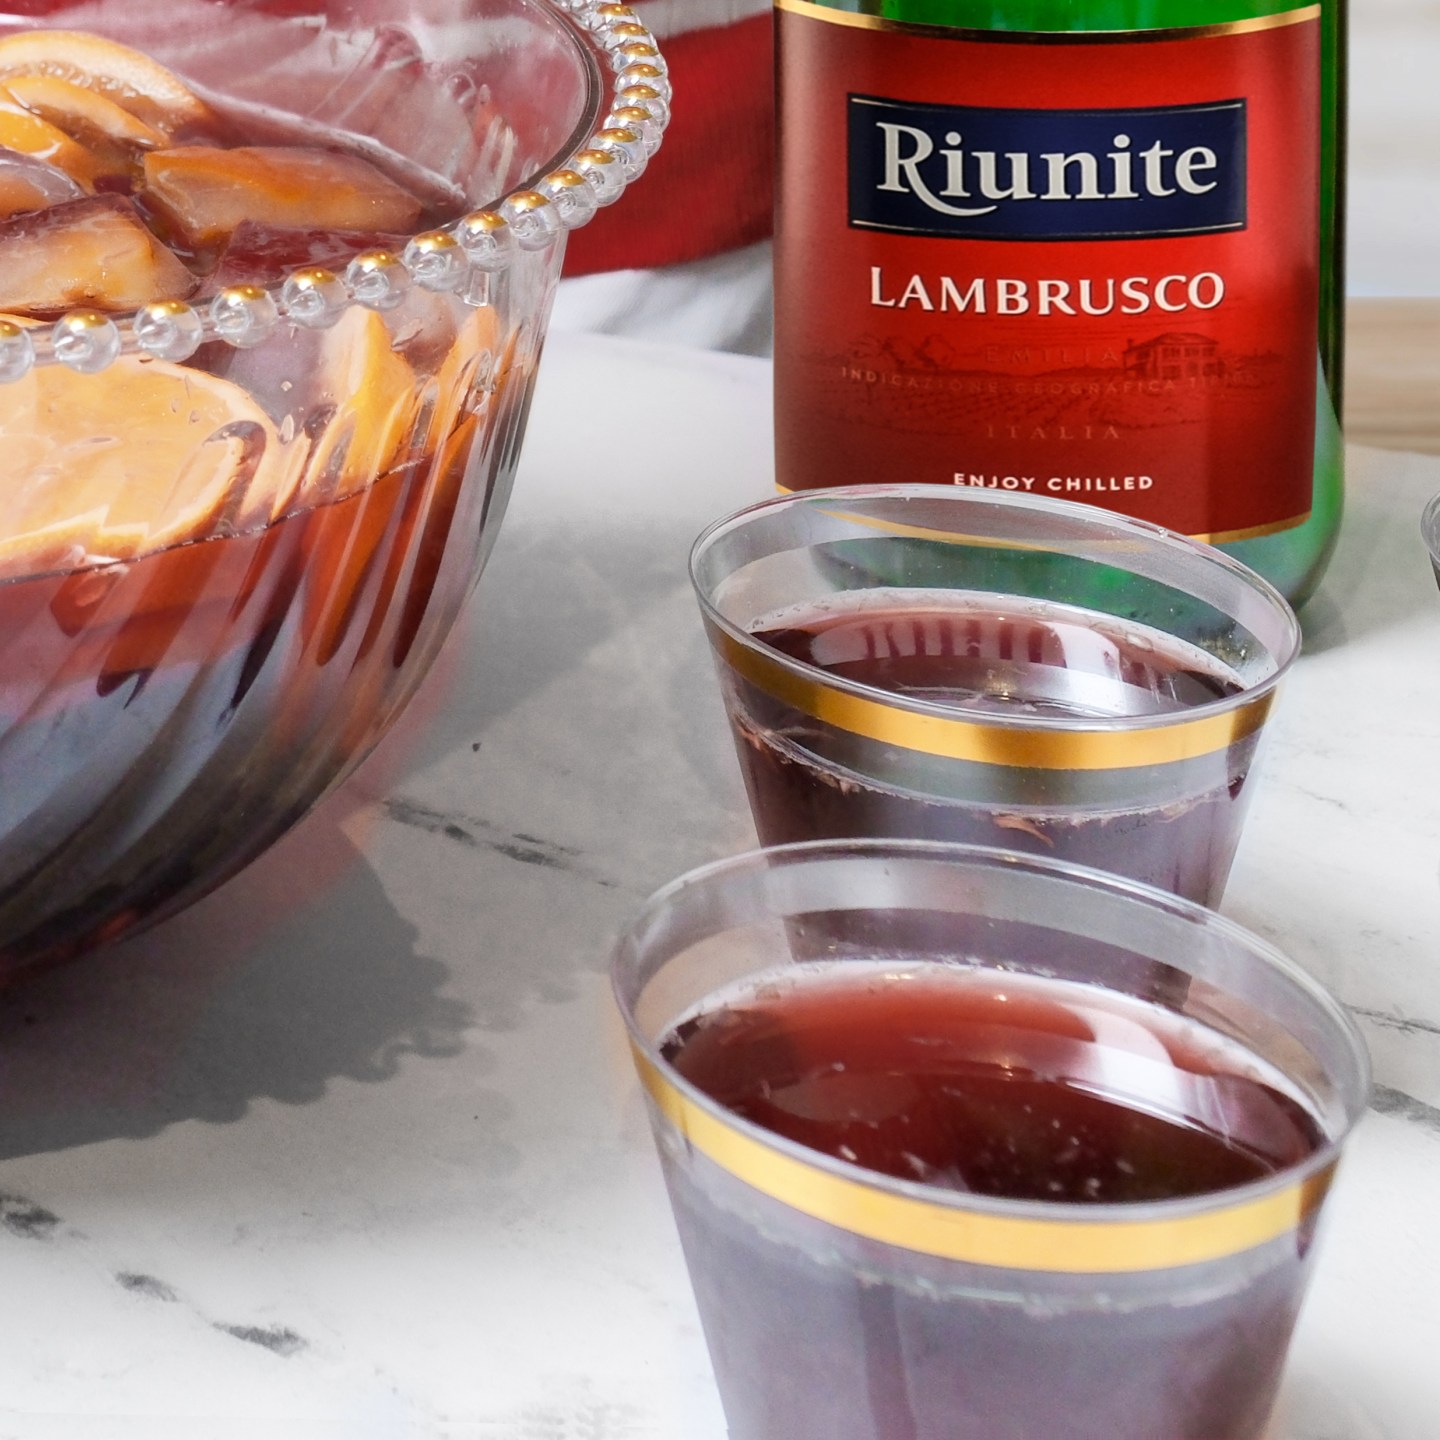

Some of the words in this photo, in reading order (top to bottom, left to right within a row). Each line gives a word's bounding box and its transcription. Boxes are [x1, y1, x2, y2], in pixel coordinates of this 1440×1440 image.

[875, 121, 1218, 217] Riunite
[869, 266, 1225, 316] LAMBRUSCO
[986, 424, 1120, 440] ITALIA
[953, 472, 1036, 490] ENJOY
[1047, 475, 1154, 491] CHILLED
